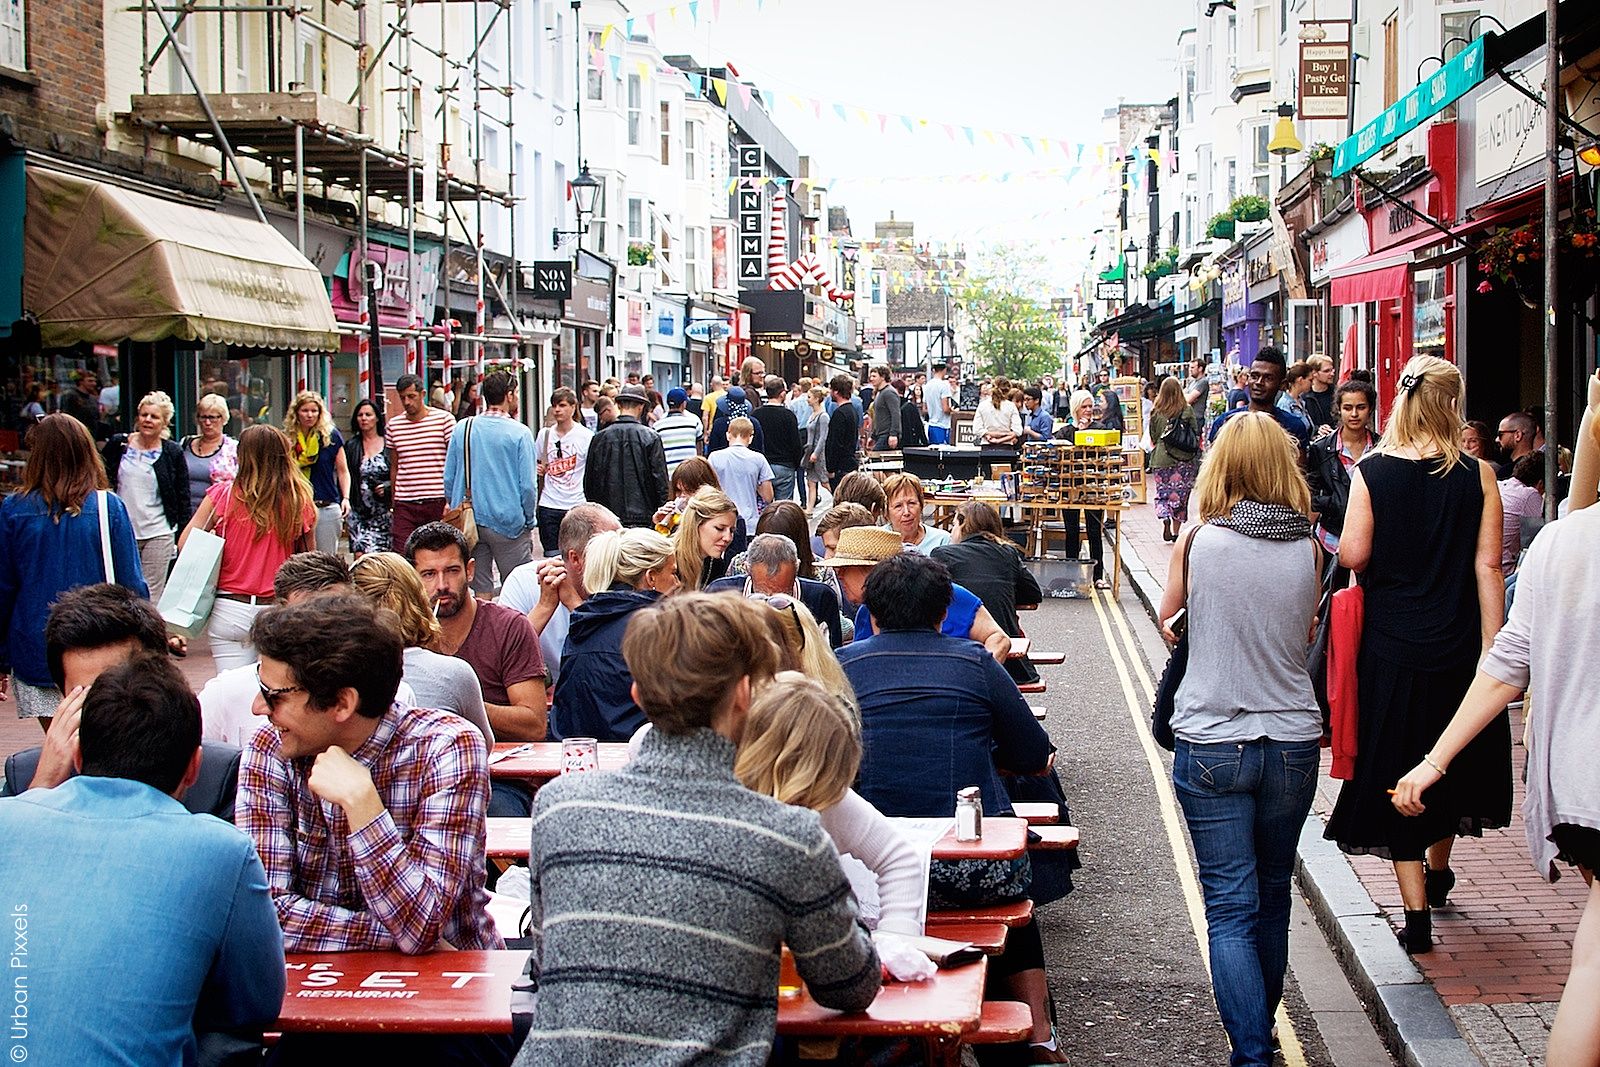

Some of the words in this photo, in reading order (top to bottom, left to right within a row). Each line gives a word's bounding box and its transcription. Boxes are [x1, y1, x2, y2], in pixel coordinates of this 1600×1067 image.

[1312, 62, 1331, 74] Buy
[1333, 62, 1338, 71] 1
[1305, 73, 1328, 85] Pasty
[1329, 73, 1346, 83] Get
[1312, 85, 1317, 94] 1
[1319, 85, 1339, 94] Free
[1489, 106, 1513, 150] NEXT
[744, 150, 759, 275] CINEMA
[540, 269, 566, 280] NOA
[540, 281, 566, 292] NOA
[296, 990, 420, 999] RESTAURANT
